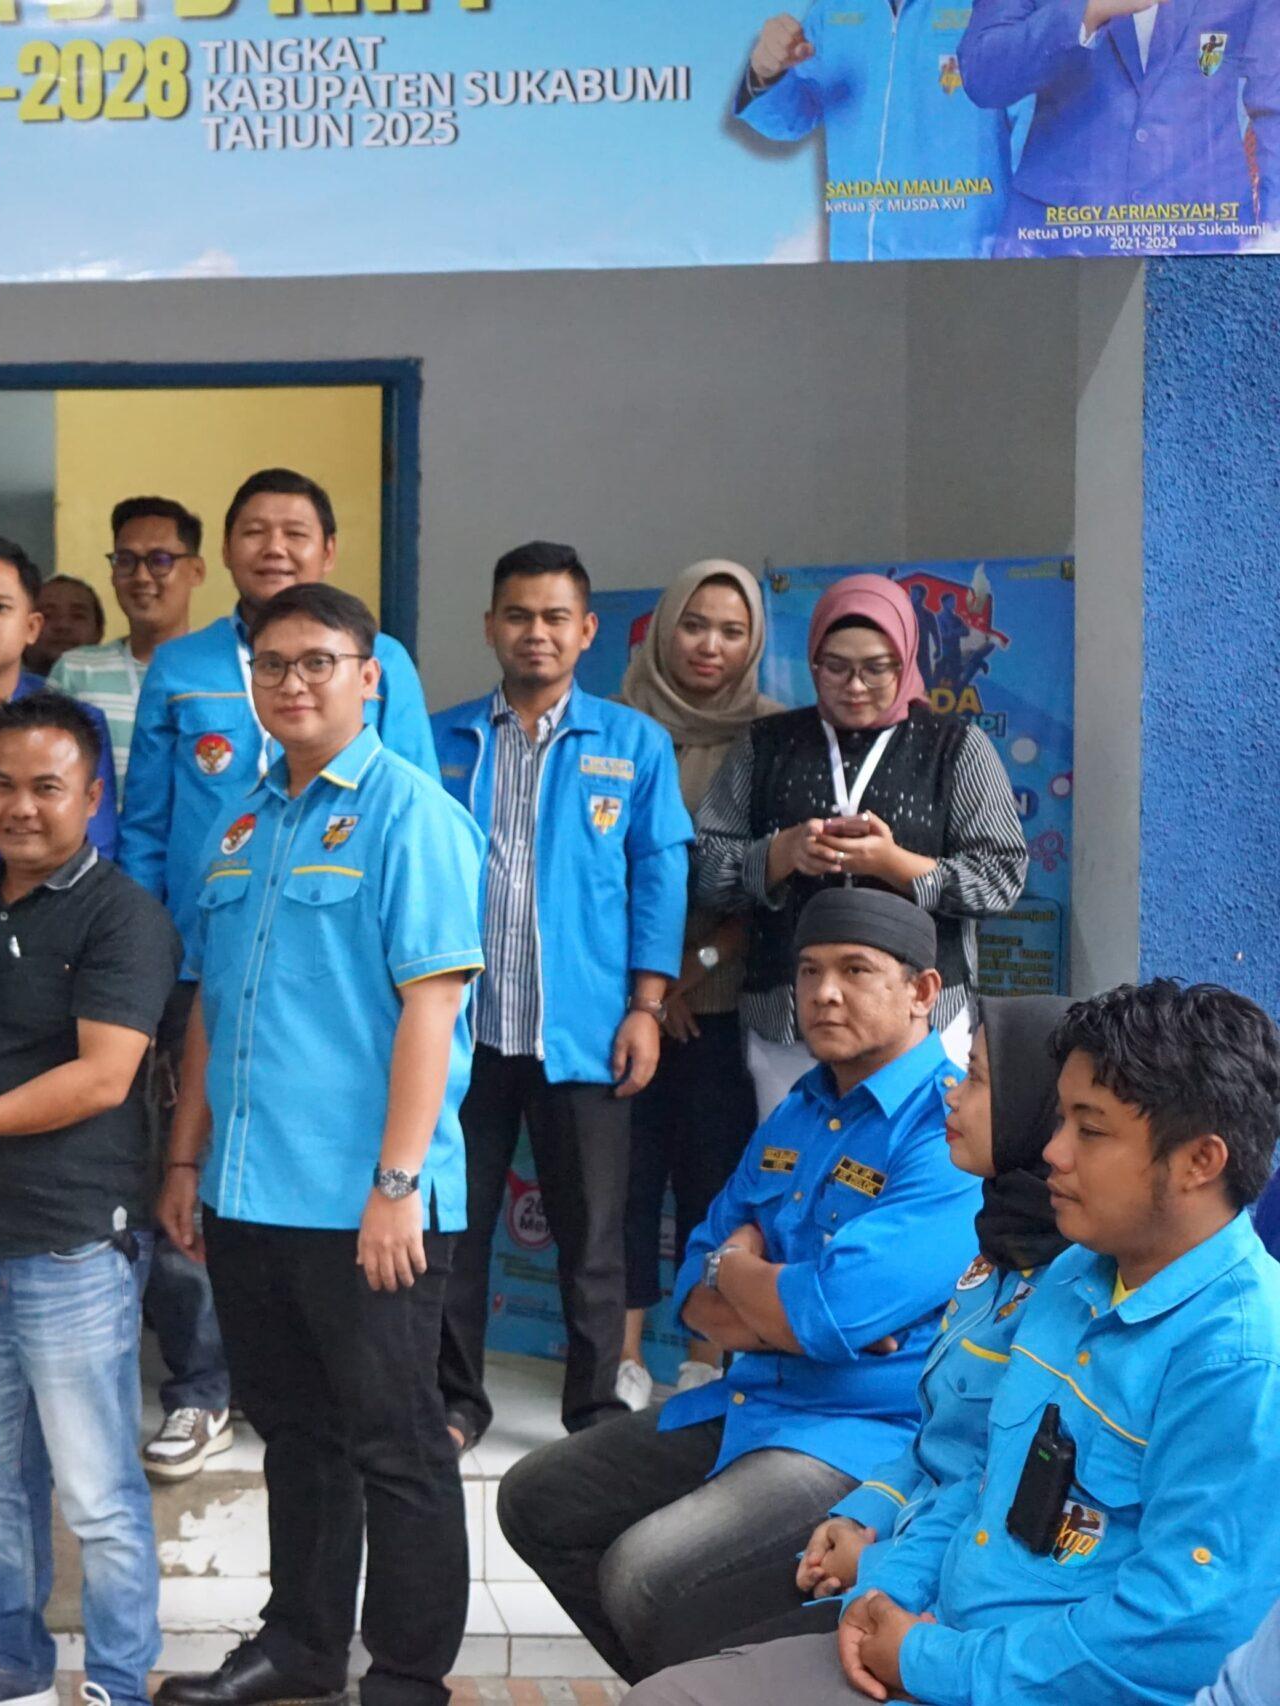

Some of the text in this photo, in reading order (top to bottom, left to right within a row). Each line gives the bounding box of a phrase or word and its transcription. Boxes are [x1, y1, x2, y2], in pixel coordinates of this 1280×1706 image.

[199, 36, 384, 74] TINGKAT
[203, 66, 691, 112] KABUPATEN SUKABUMI
[202, 111, 459, 150] TAHUN 2025
[825, 176, 993, 199] SAHDAN MAULANA
[888, 198, 939, 212] MUSDA
[942, 197, 966, 210] XVI
[1045, 202, 1240, 223] REGGY AFRIANSYAH,ST
[1017, 221, 1266, 240] Ketua DPD KNPI KNPI Kab Sukabumi
[1109, 236, 1178, 250] 2021-2024
